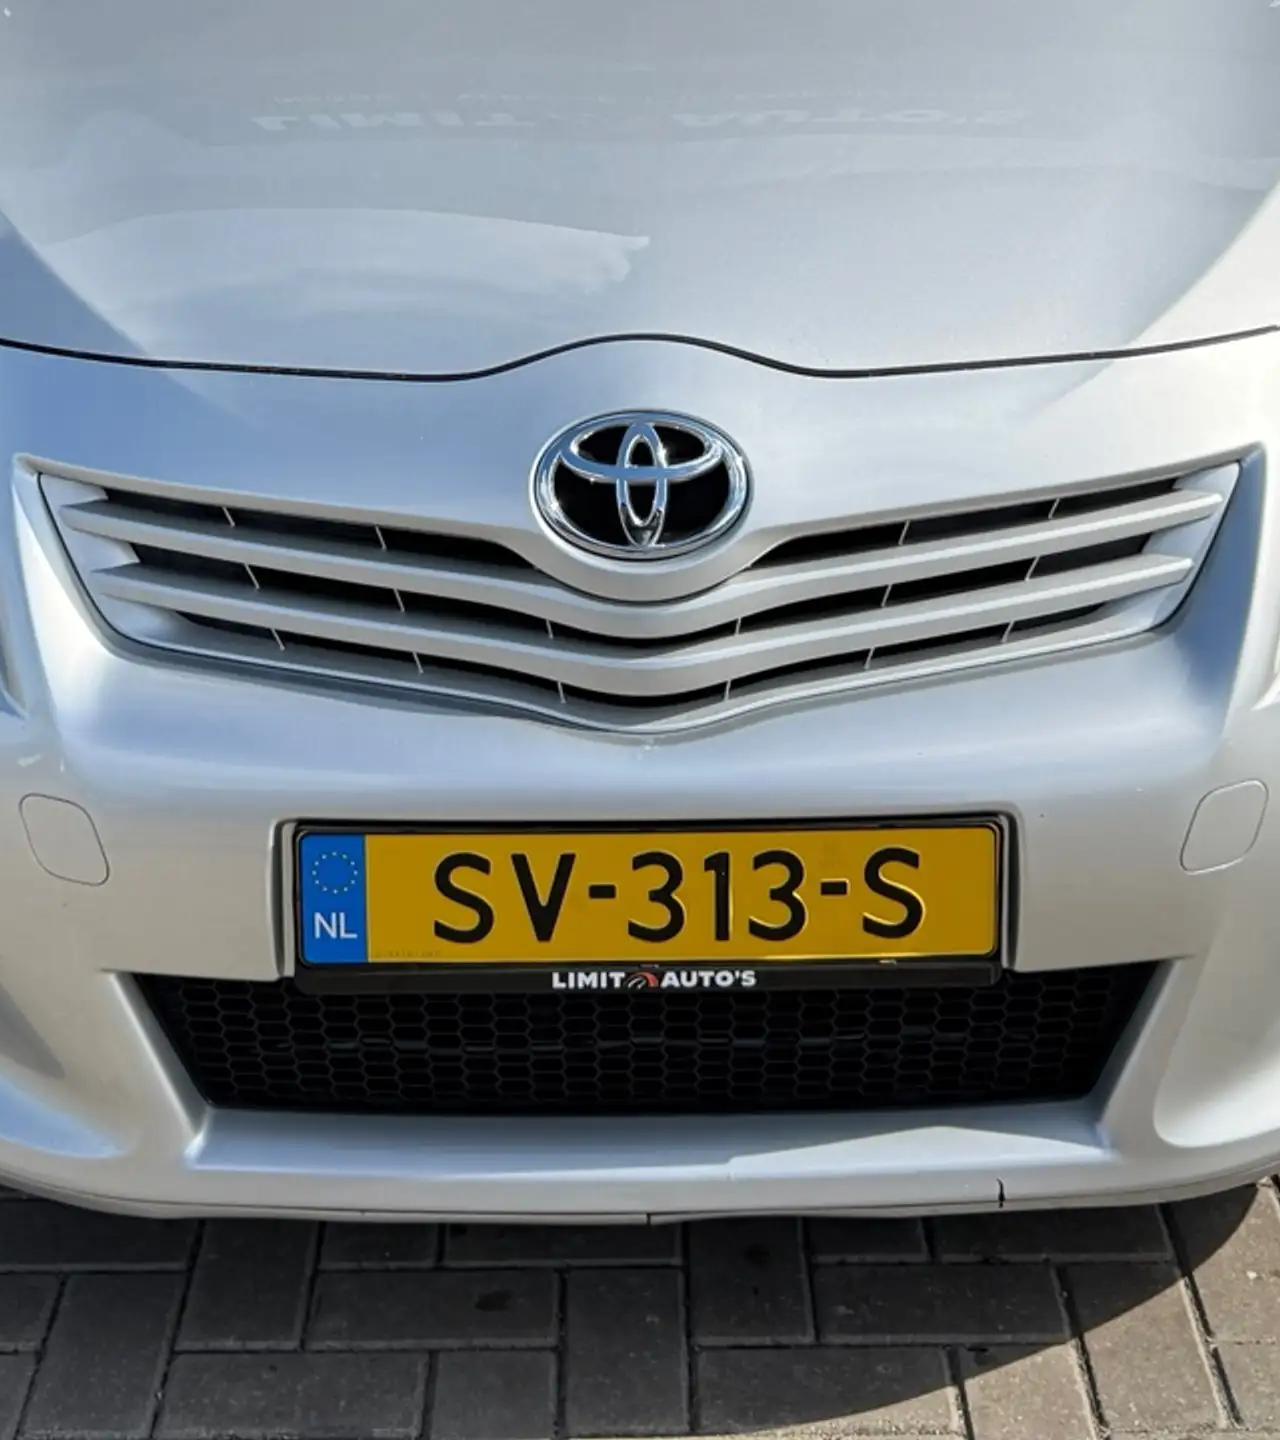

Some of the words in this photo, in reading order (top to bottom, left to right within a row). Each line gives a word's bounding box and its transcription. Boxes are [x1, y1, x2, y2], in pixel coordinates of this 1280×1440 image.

[433, 847, 927, 942] SV-313-S
[314, 912, 358, 940] NL
[552, 971, 626, 990] LIMIT
[660, 969, 757, 989] AUTO'S
